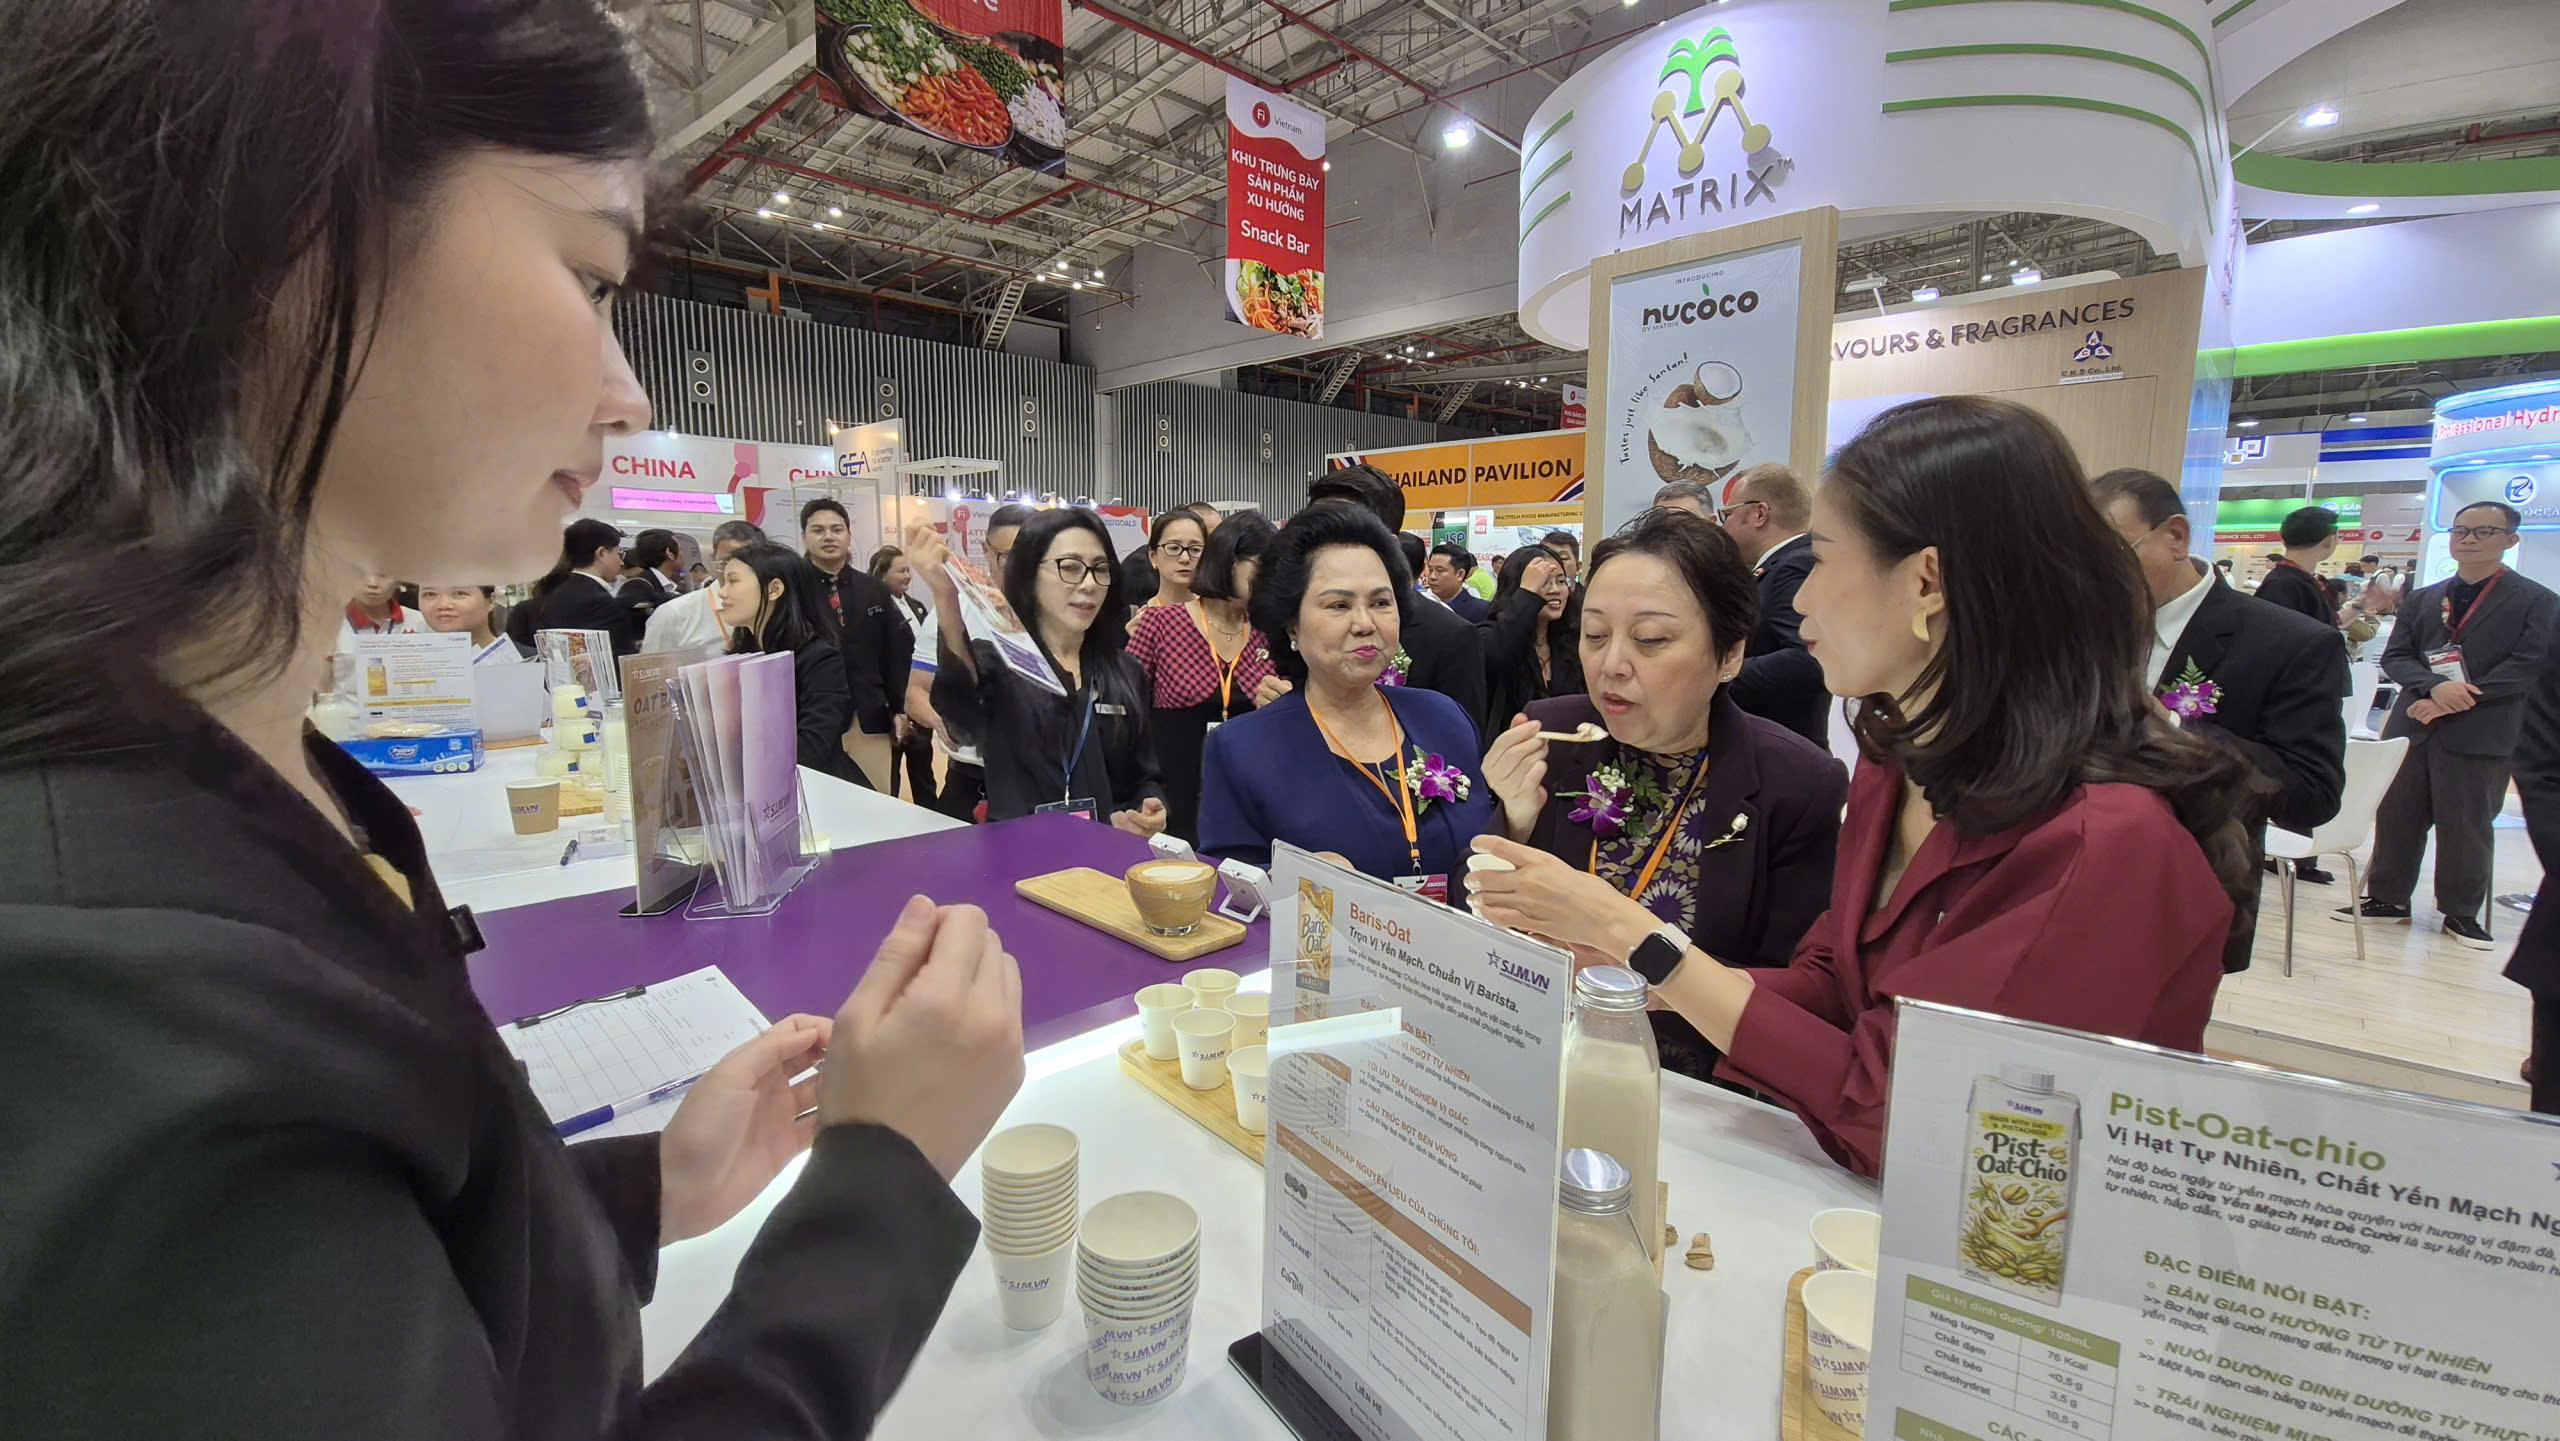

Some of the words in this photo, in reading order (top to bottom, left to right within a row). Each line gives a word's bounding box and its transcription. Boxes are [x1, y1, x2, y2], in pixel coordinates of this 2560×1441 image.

[1257, 108, 1266, 122] Fi
[1274, 115, 1303, 135] Vietnam
[1232, 148, 1256, 169] KHU
[1259, 157, 1297, 184] TRƯNG
[1299, 171, 1320, 191] BÀY
[1247, 174, 1271, 192] SẢN
[1273, 181, 1305, 204] PHẨM
[1620, 165, 1776, 236] MATRIX
[1247, 191, 1263, 208] XU
[1265, 197, 1304, 221] HƯỚNG
[1240, 219, 1284, 248] Snack
[1286, 233, 1310, 255] Bar
[1675, 269, 1725, 285] INTRODUCING
[1642, 290, 1759, 326] nucoco
[1652, 322, 1679, 331] MATRIX
[1832, 330, 1919, 362] VOURS
[1925, 328, 1944, 349] &
[1951, 298, 2136, 346] FRAGRANCES
[1631, 386, 1648, 404] like
[2514, 405, 2560, 429] Hydr
[611, 455, 697, 480] CHINA
[838, 451, 870, 477] GEA
[1388, 467, 1467, 488] HAILAND
[1474, 458, 1573, 483] PAVILION
[1350, 901, 1411, 945] Baris-Oat
[1306, 934, 1326, 954] Oat
[1349, 925, 1368, 944] Trọn
[1369, 935, 1378, 951] Vị
[1428, 962, 1461, 986] Chuẩn
[1464, 976, 1475, 995] Vị
[1477, 984, 1519, 1013] Barista.
[1500, 959, 1551, 990] S.I.M.VN
[1444, 1062, 1471, 1083] NHIÊN
[1408, 1083, 1438, 1108] NGHIỆM
[1449, 1105, 1469, 1126] GIÁC
[1984, 1132, 2047, 1159] Pist-
[2109, 1091, 2386, 1171] Pist-Oat-chio
[1435, 1142, 1458, 1163] VỮNG
[1977, 1154, 2068, 1182] Oat-Chio
[2106, 1123, 2128, 1146] Vị
[2134, 1131, 2173, 1154] Hạt
[2180, 1140, 2216, 1165] Tự
[2223, 1151, 2307, 1185] Nhiên,
[2316, 1171, 2381, 1198] Chất
[2389, 1184, 2440, 1210] Yến
[2449, 1196, 2521, 1222] Mạch
[2531, 1212, 2560, 1237] Ng
[1388, 1186, 1407, 1203] LIỆU
[1409, 1197, 1426, 1218] CỦA
[1428, 1211, 1460, 1241] CHÚNG
[1461, 1234, 1480, 1255] TÔI:
[1008, 1277, 1049, 1291] S.I.M.VN
[1123, 1339, 1167, 1361] S.I.M.VN
[2214, 1297, 2266, 1320] GIAO
[2426, 1349, 2493, 1375] NHIÊN
[2299, 1378, 2350, 1403] DINH
